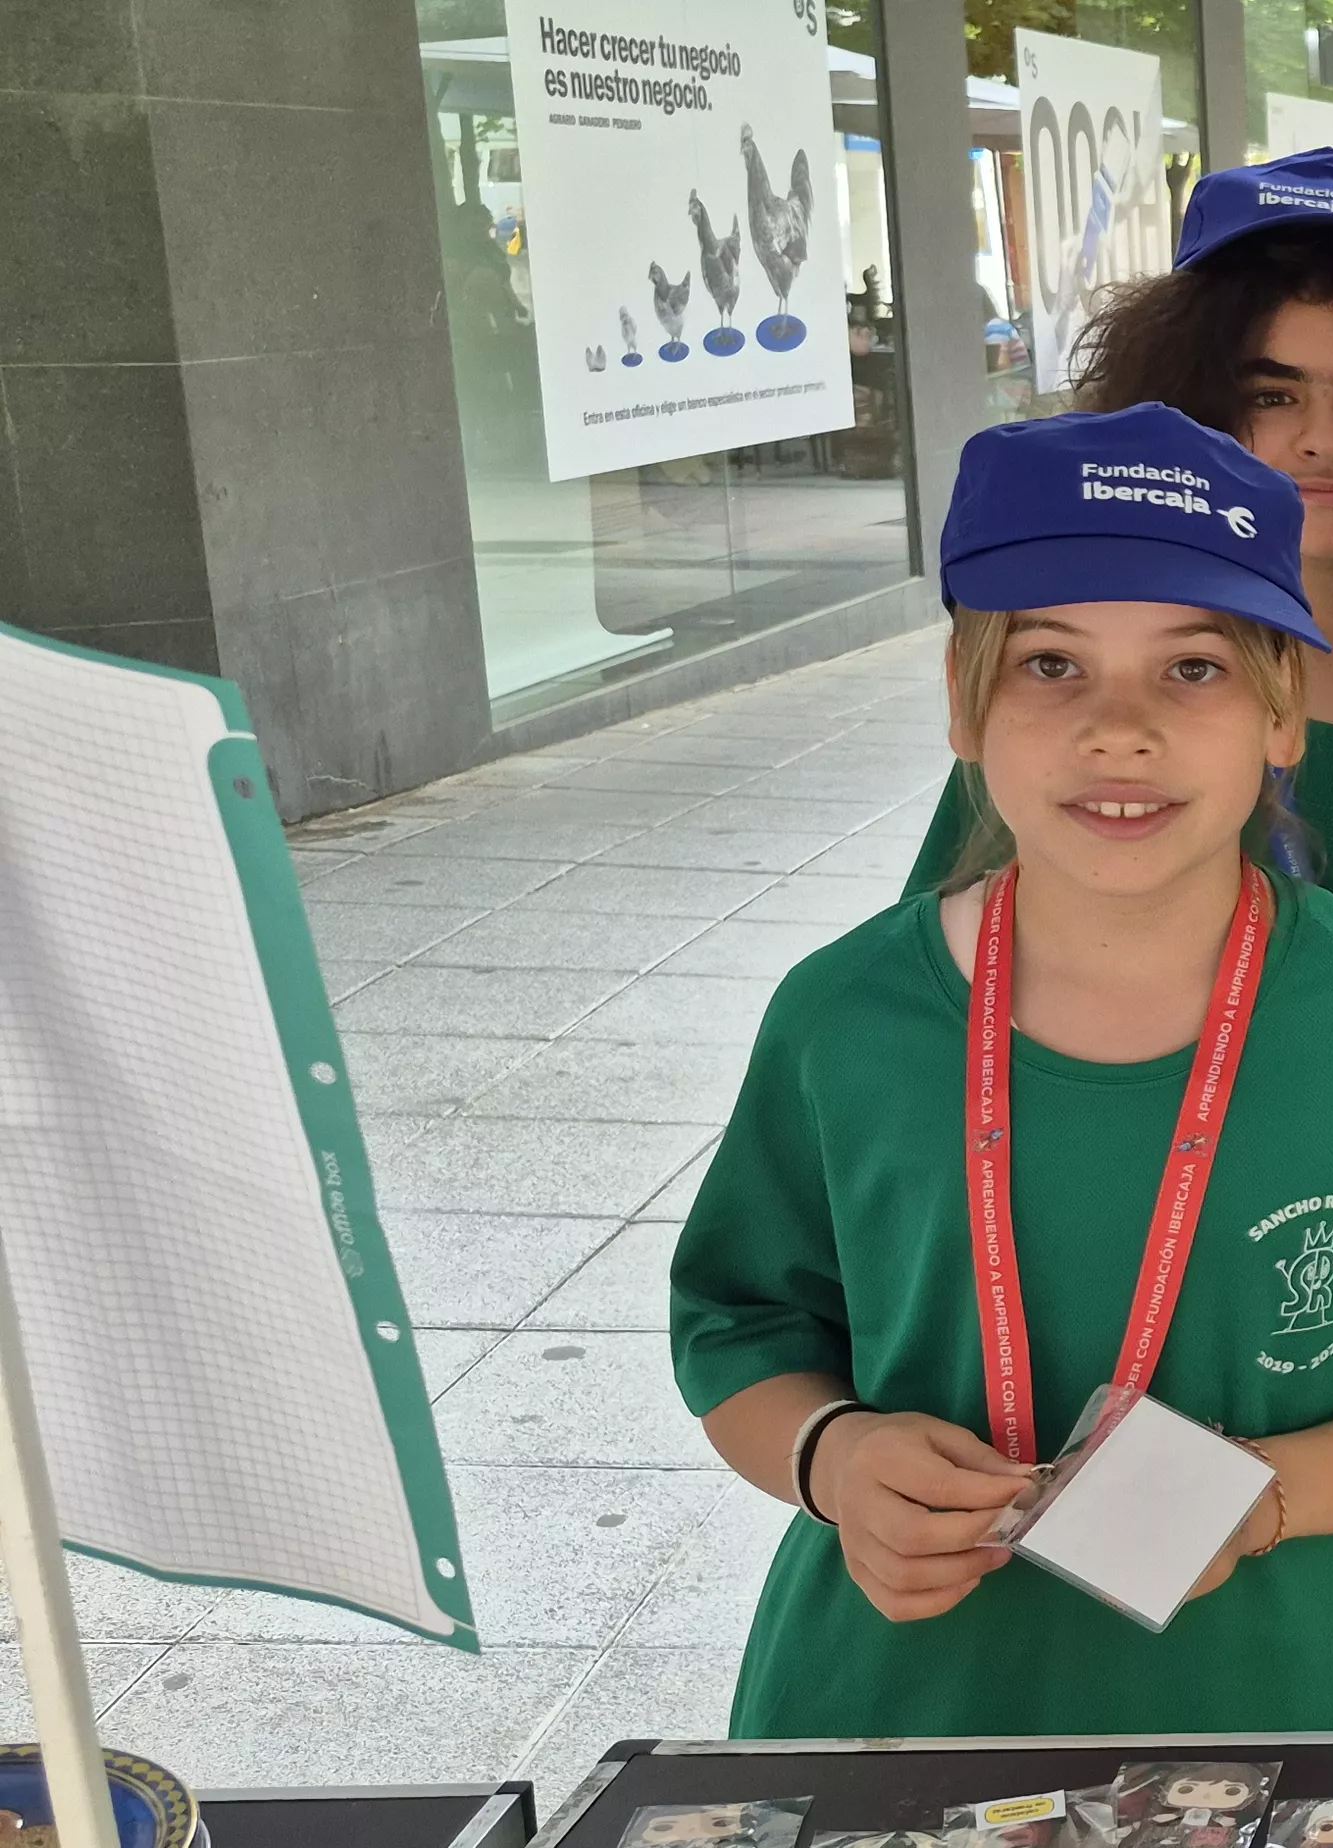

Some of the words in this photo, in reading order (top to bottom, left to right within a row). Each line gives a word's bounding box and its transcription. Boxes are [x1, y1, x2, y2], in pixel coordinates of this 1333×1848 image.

[540, 16, 597, 59] Hacer
[600, 33, 657, 67] crecer
[659, 35, 677, 68] tu
[680, 43, 741, 81] negocio
[545, 68, 568, 98] es
[570, 69, 640, 104] nuestro
[642, 77, 712, 115] negocio.
[1082, 463, 1210, 491] Fundación
[1082, 481, 1212, 515] Ibercaja
[988, 936, 999, 965] CON
[1227, 924, 1258, 1007] EMPRENDER
[982, 969, 997, 1050] FUNDACIÓN
[1224, 1009, 1237, 1020] A
[982, 1054, 994, 1125] IBERCAJA
[1197, 1022, 1233, 1122] APRENDIENDO
[321, 1149, 342, 1186] box
[982, 1159, 999, 1267] APRENDIENDO
[1248, 1196, 1322, 1242] SANCHO
[990, 1270, 1002, 1281] A
[1136, 1326, 1154, 1360] CON
[1146, 1237, 1175, 1324] FUNDACIÓN
[1168, 1162, 1197, 1234] IBERCAJA
[992, 1286, 1013, 1377] EMPRENDER
[1256, 1351, 1294, 1374] 2019
[1002, 1380, 1017, 1414] CON
